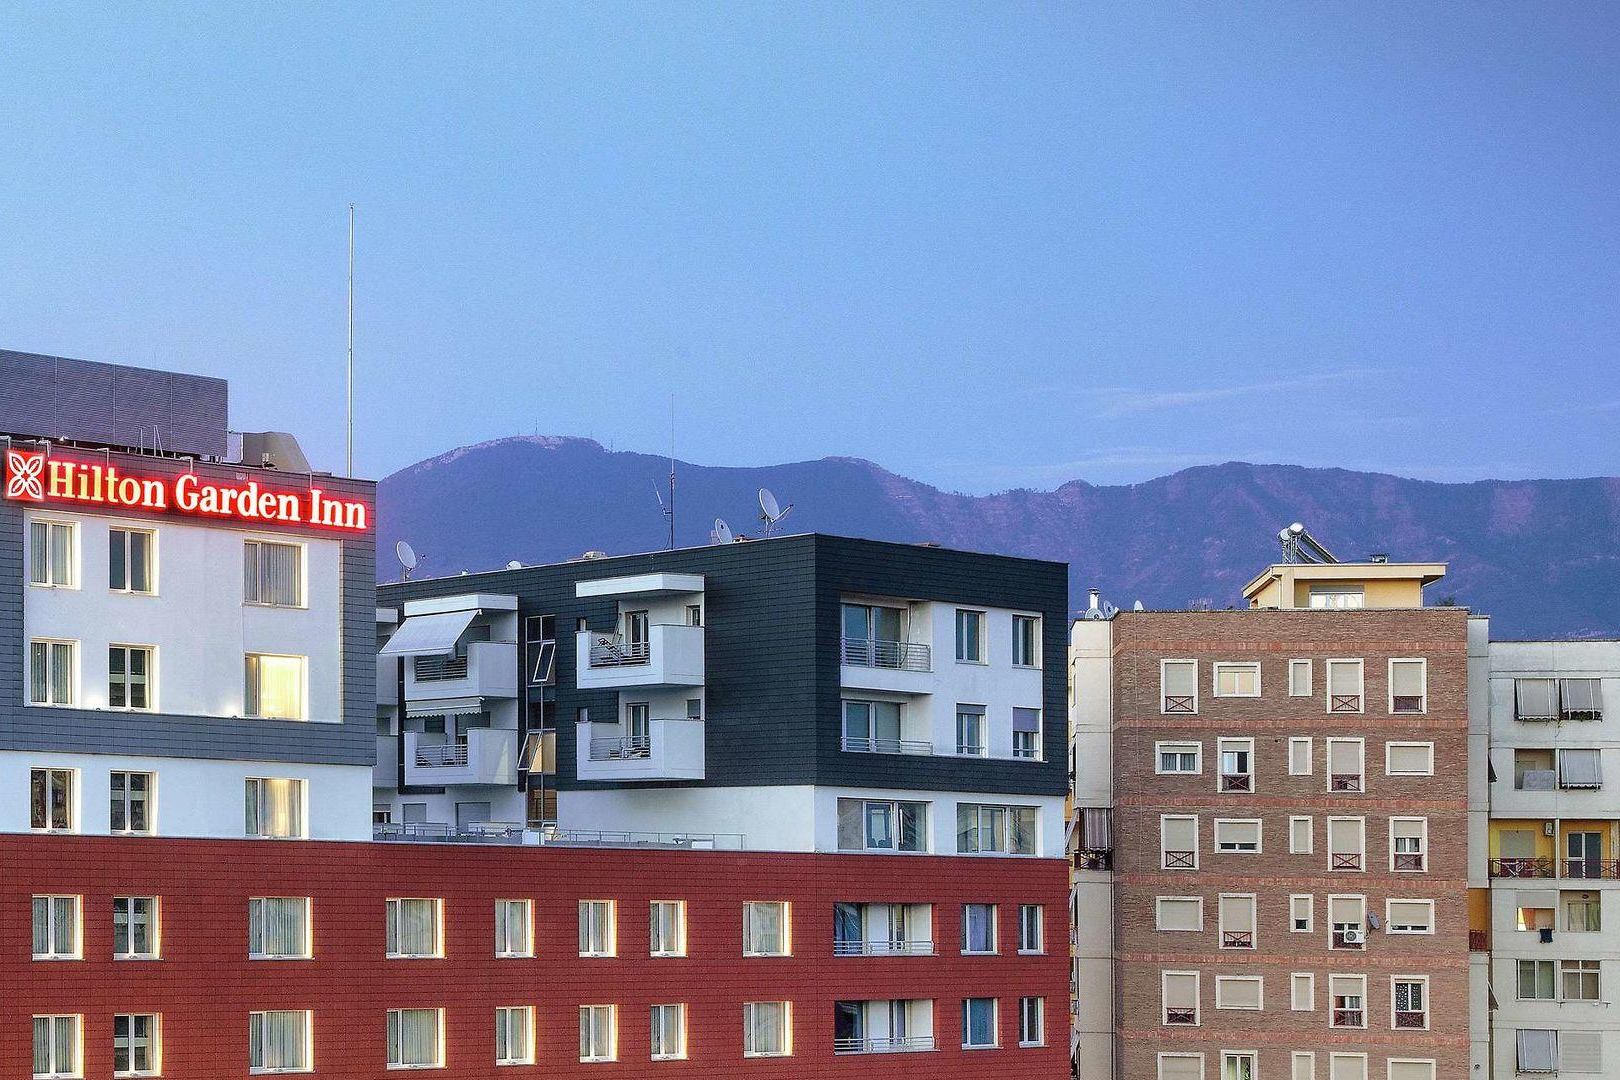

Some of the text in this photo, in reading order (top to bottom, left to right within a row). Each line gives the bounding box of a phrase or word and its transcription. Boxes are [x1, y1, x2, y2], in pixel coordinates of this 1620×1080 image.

[47, 461, 366, 529] Hilton Garden Inn
